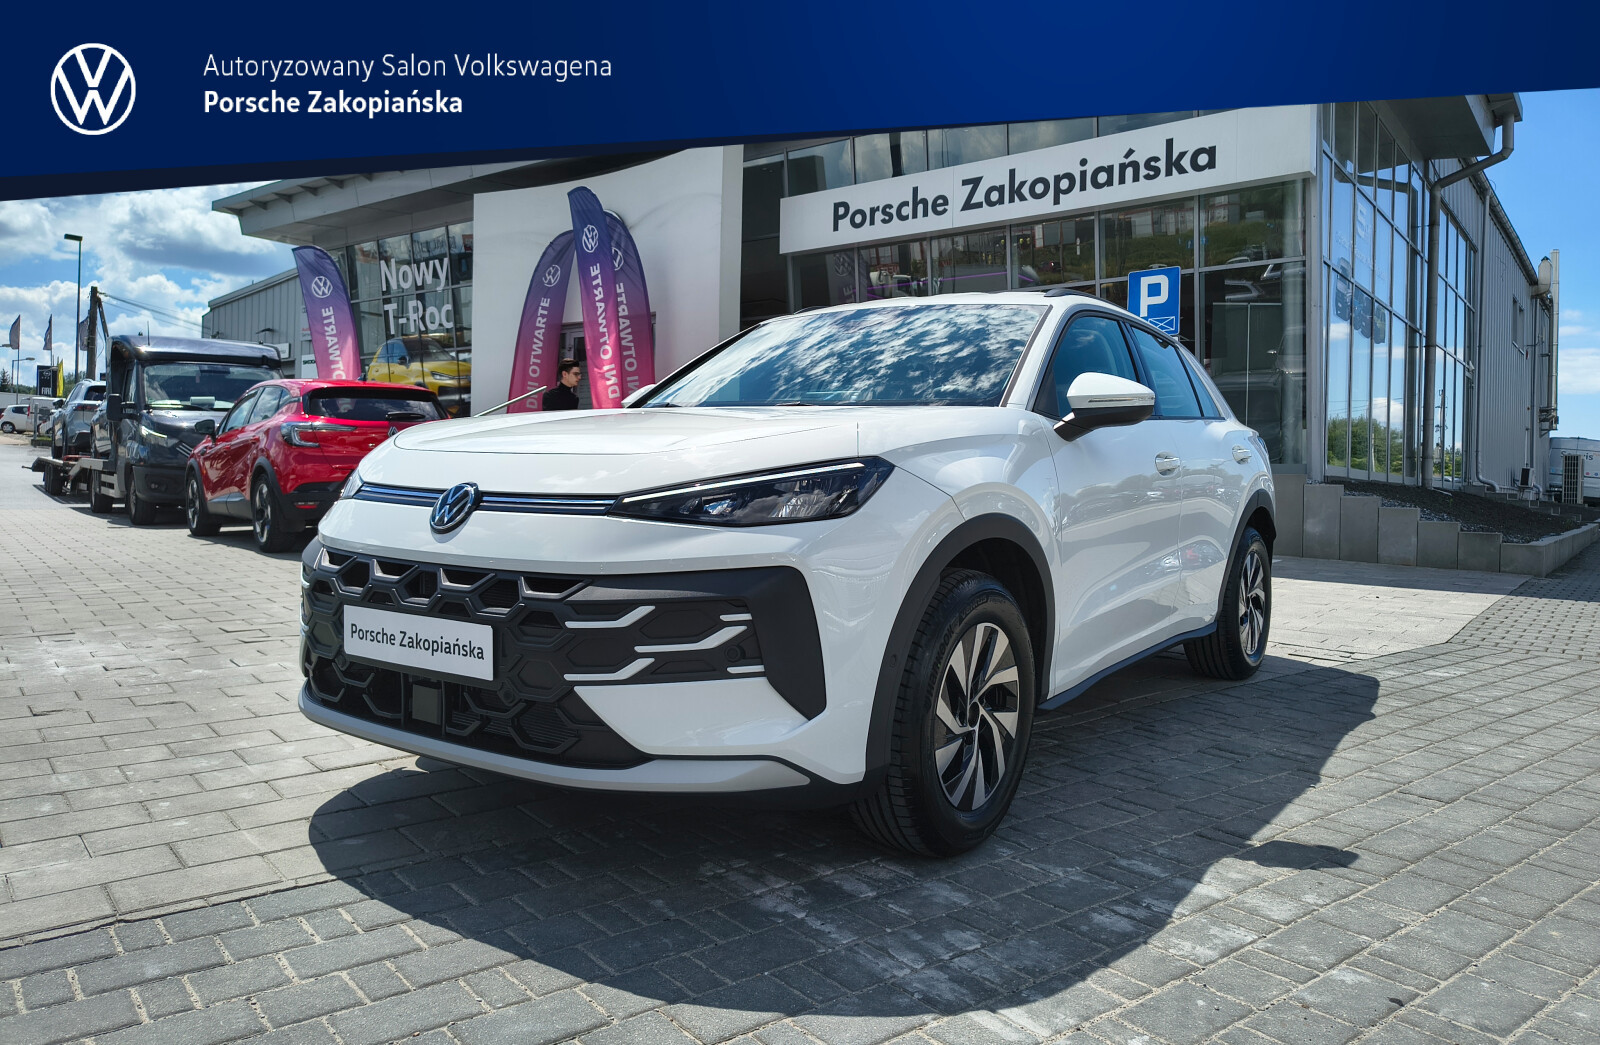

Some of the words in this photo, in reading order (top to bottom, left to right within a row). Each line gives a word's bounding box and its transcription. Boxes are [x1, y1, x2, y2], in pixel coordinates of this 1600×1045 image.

[831, 185, 949, 233] Porsche
[960, 137, 1217, 213] Zakopiańska
[380, 257, 449, 293] Nowy
[1139, 274, 1169, 318] P
[383, 299, 454, 335] T-Roc
[528, 297, 551, 378] OTWARTE
[350, 623, 396, 646] Porsche
[399, 630, 485, 660] Zakopiańska
